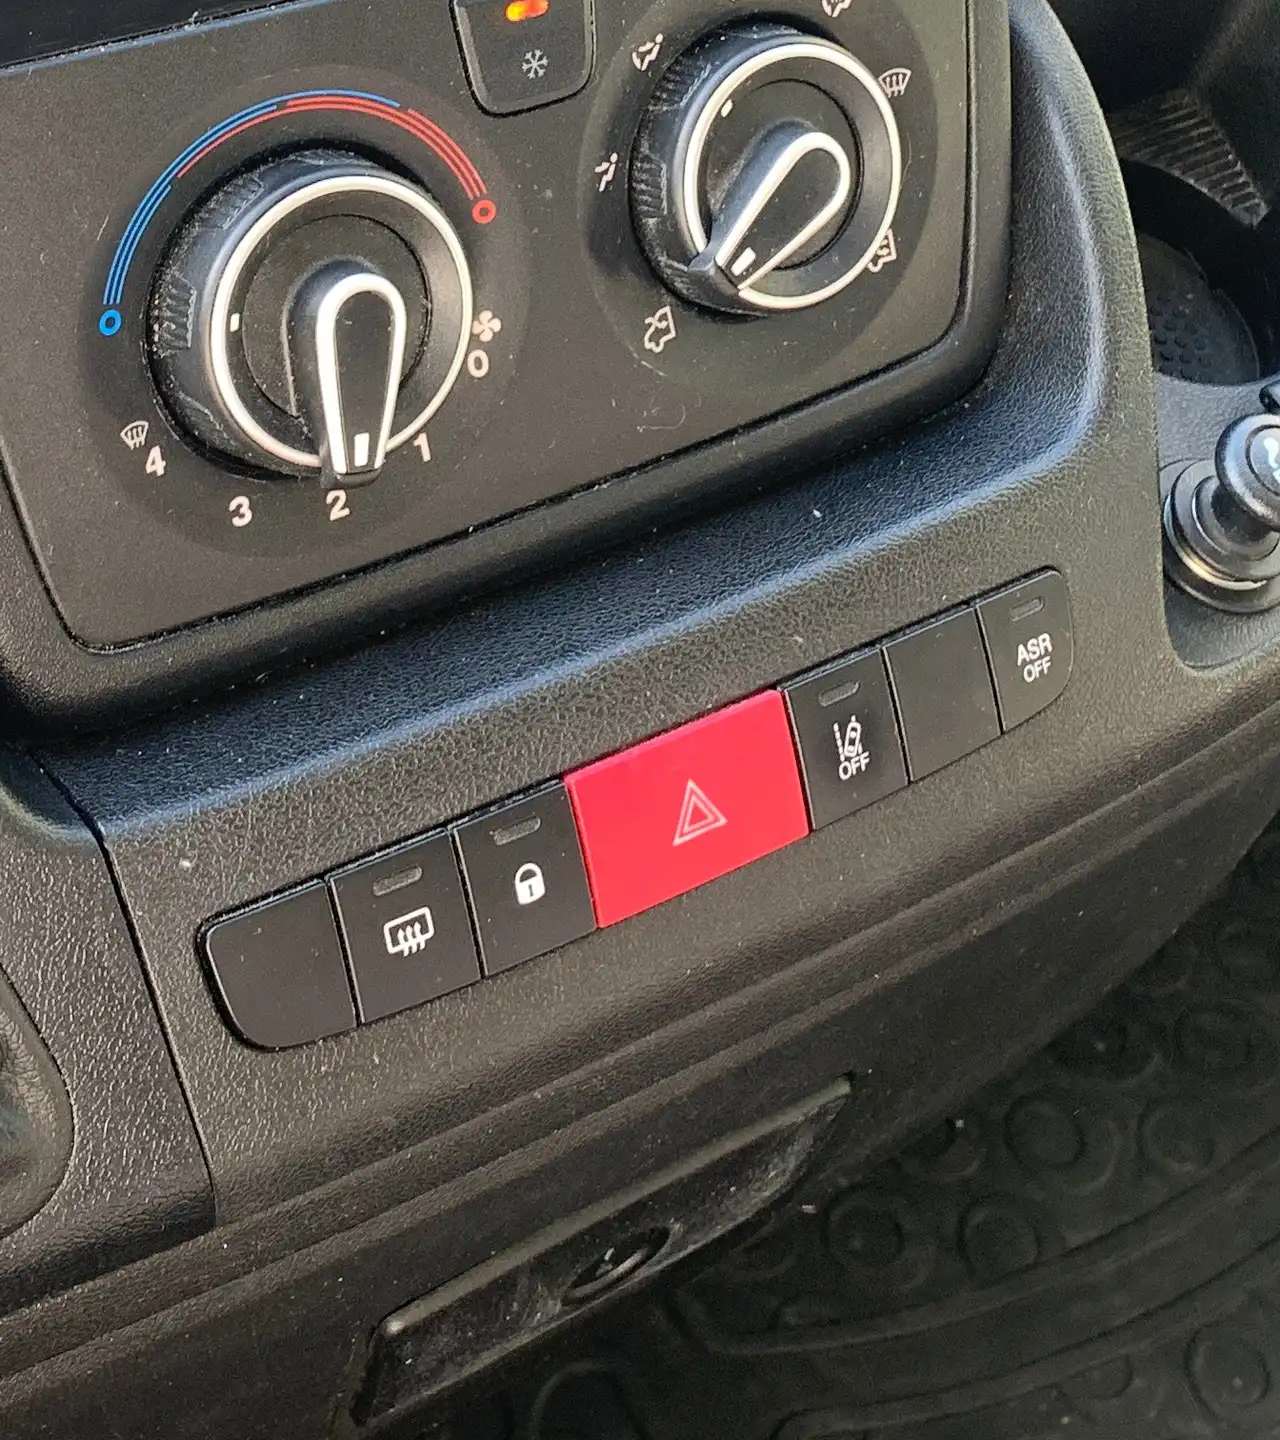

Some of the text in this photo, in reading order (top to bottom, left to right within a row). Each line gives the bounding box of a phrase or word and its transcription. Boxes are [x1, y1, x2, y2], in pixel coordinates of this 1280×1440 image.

[467, 350, 489, 378] 0
[145, 445, 167, 477] 4
[414, 433, 432, 463] 1
[228, 495, 253, 527] 3
[326, 489, 350, 522] 2
[1016, 631, 1054, 666] ASR
[1022, 653, 1052, 684] OFF
[837, 751, 871, 782] OFF
